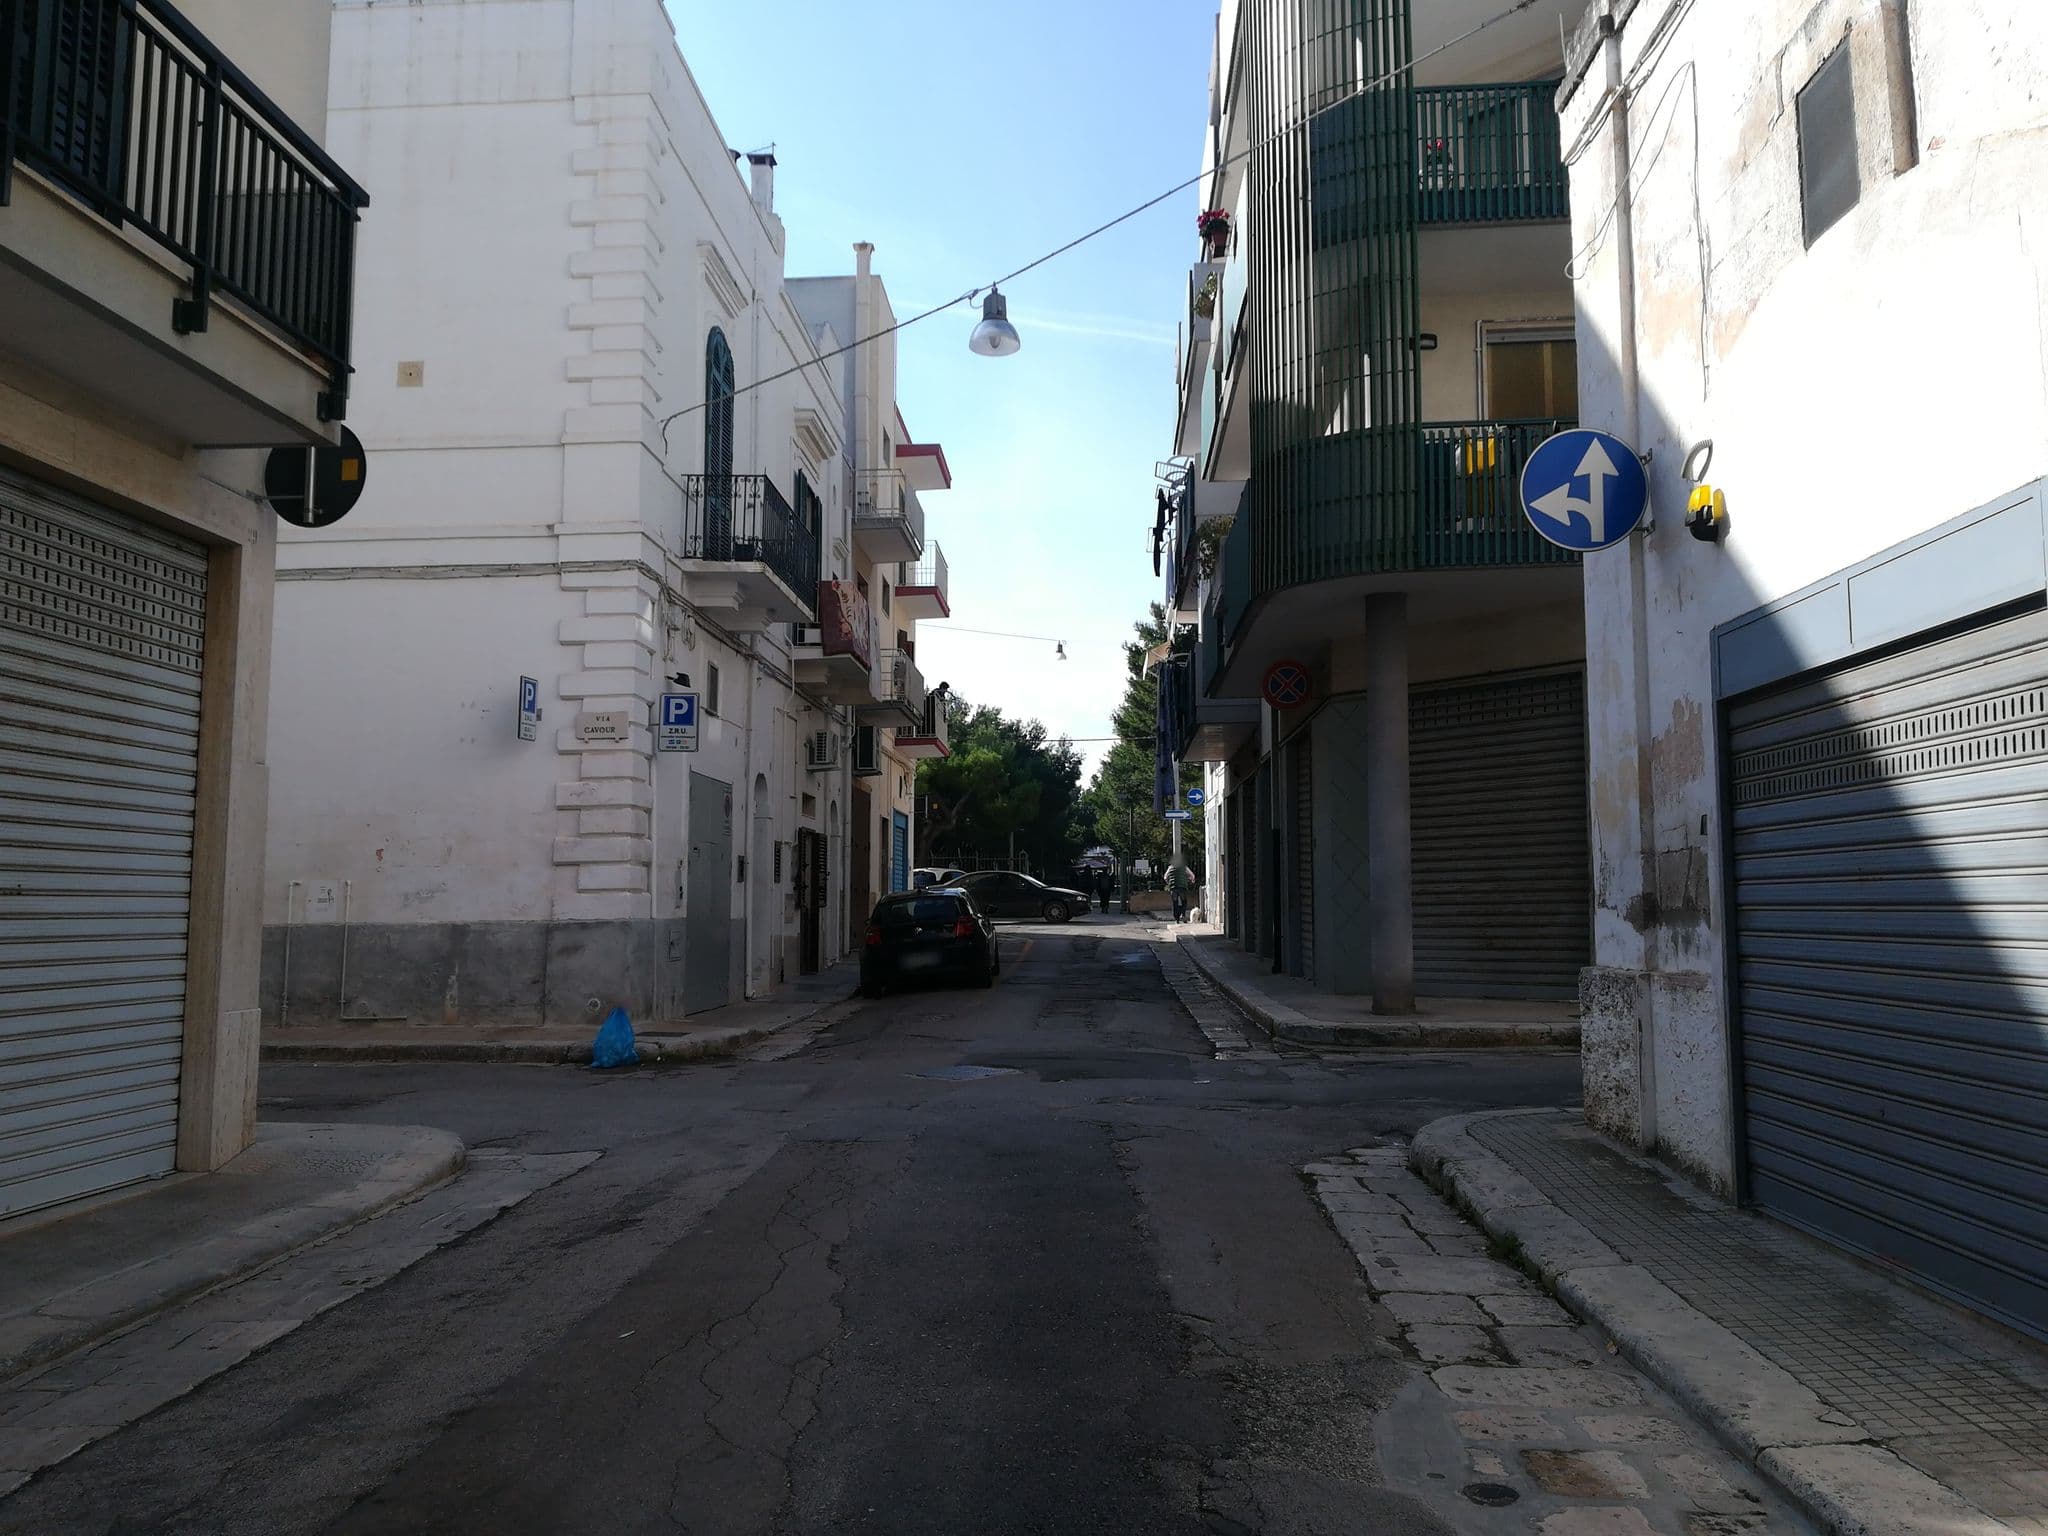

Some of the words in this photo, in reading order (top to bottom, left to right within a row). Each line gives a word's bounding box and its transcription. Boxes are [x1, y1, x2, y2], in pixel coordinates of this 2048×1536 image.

[525, 683, 534, 708] P
[669, 698, 688, 722] P
[583, 726, 616, 734] CAVOUR
